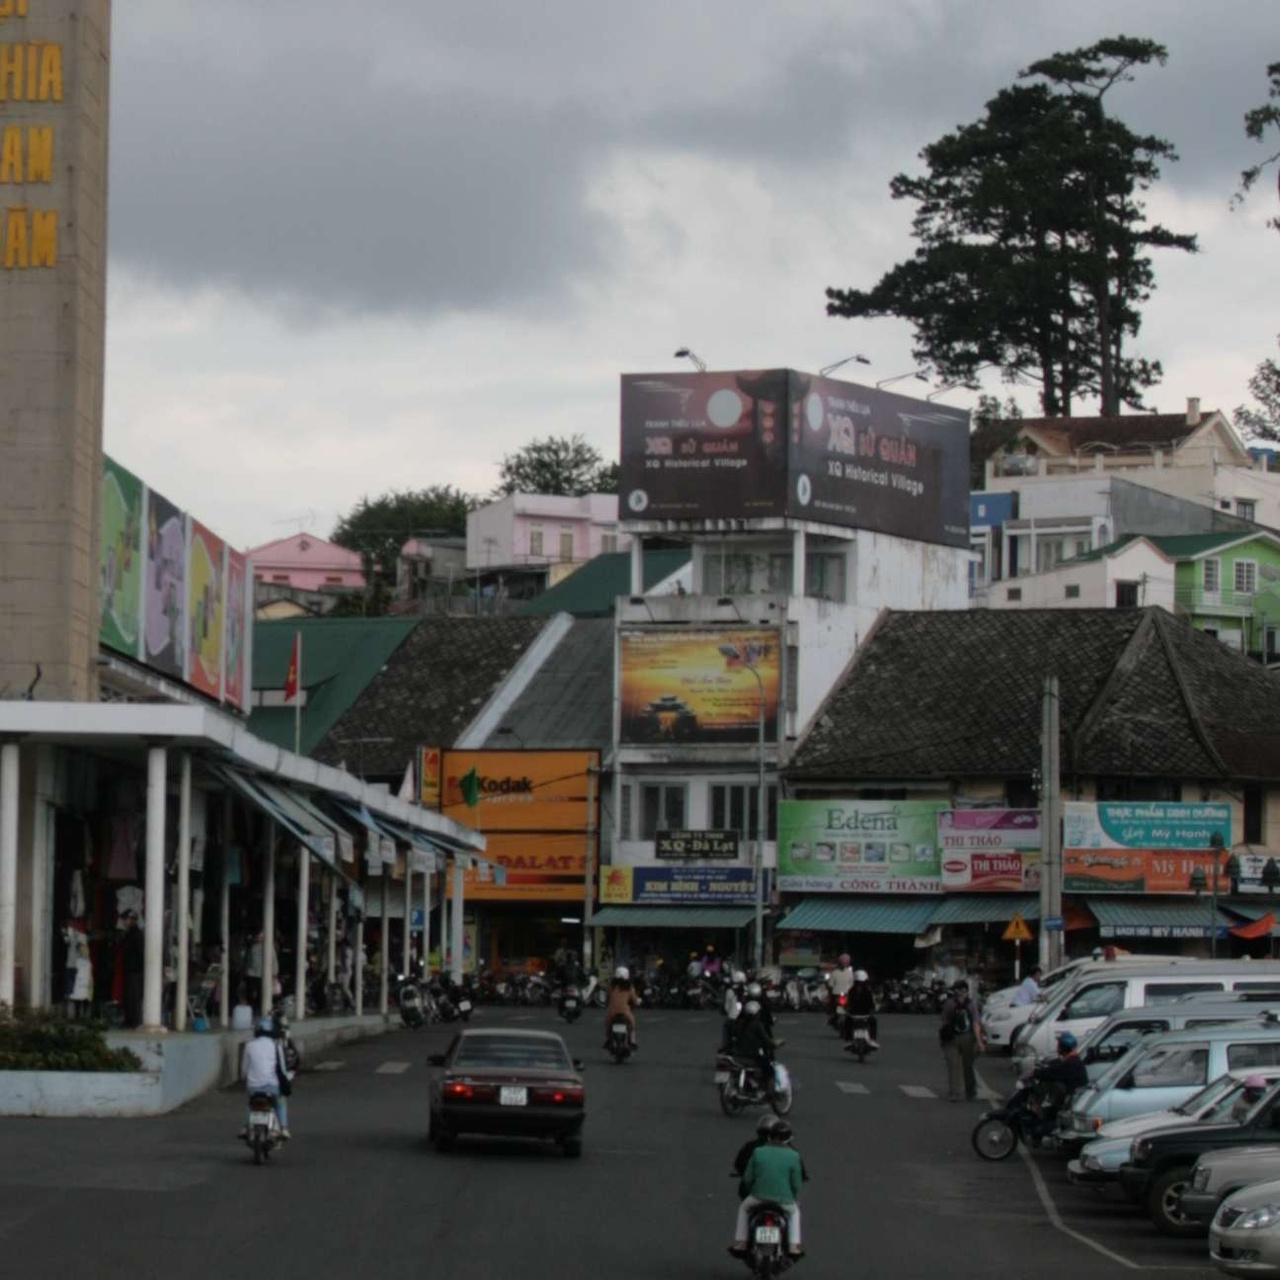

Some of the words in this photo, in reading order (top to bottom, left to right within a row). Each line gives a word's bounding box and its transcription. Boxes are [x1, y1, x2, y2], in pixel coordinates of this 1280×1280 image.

[664, 458, 710, 468] Historical
[714, 458, 747, 469] Village
[845, 464, 888, 487] Historical
[891, 473, 924, 496] Village
[477, 776, 534, 793] Kodak
[825, 807, 899, 831] Edena
